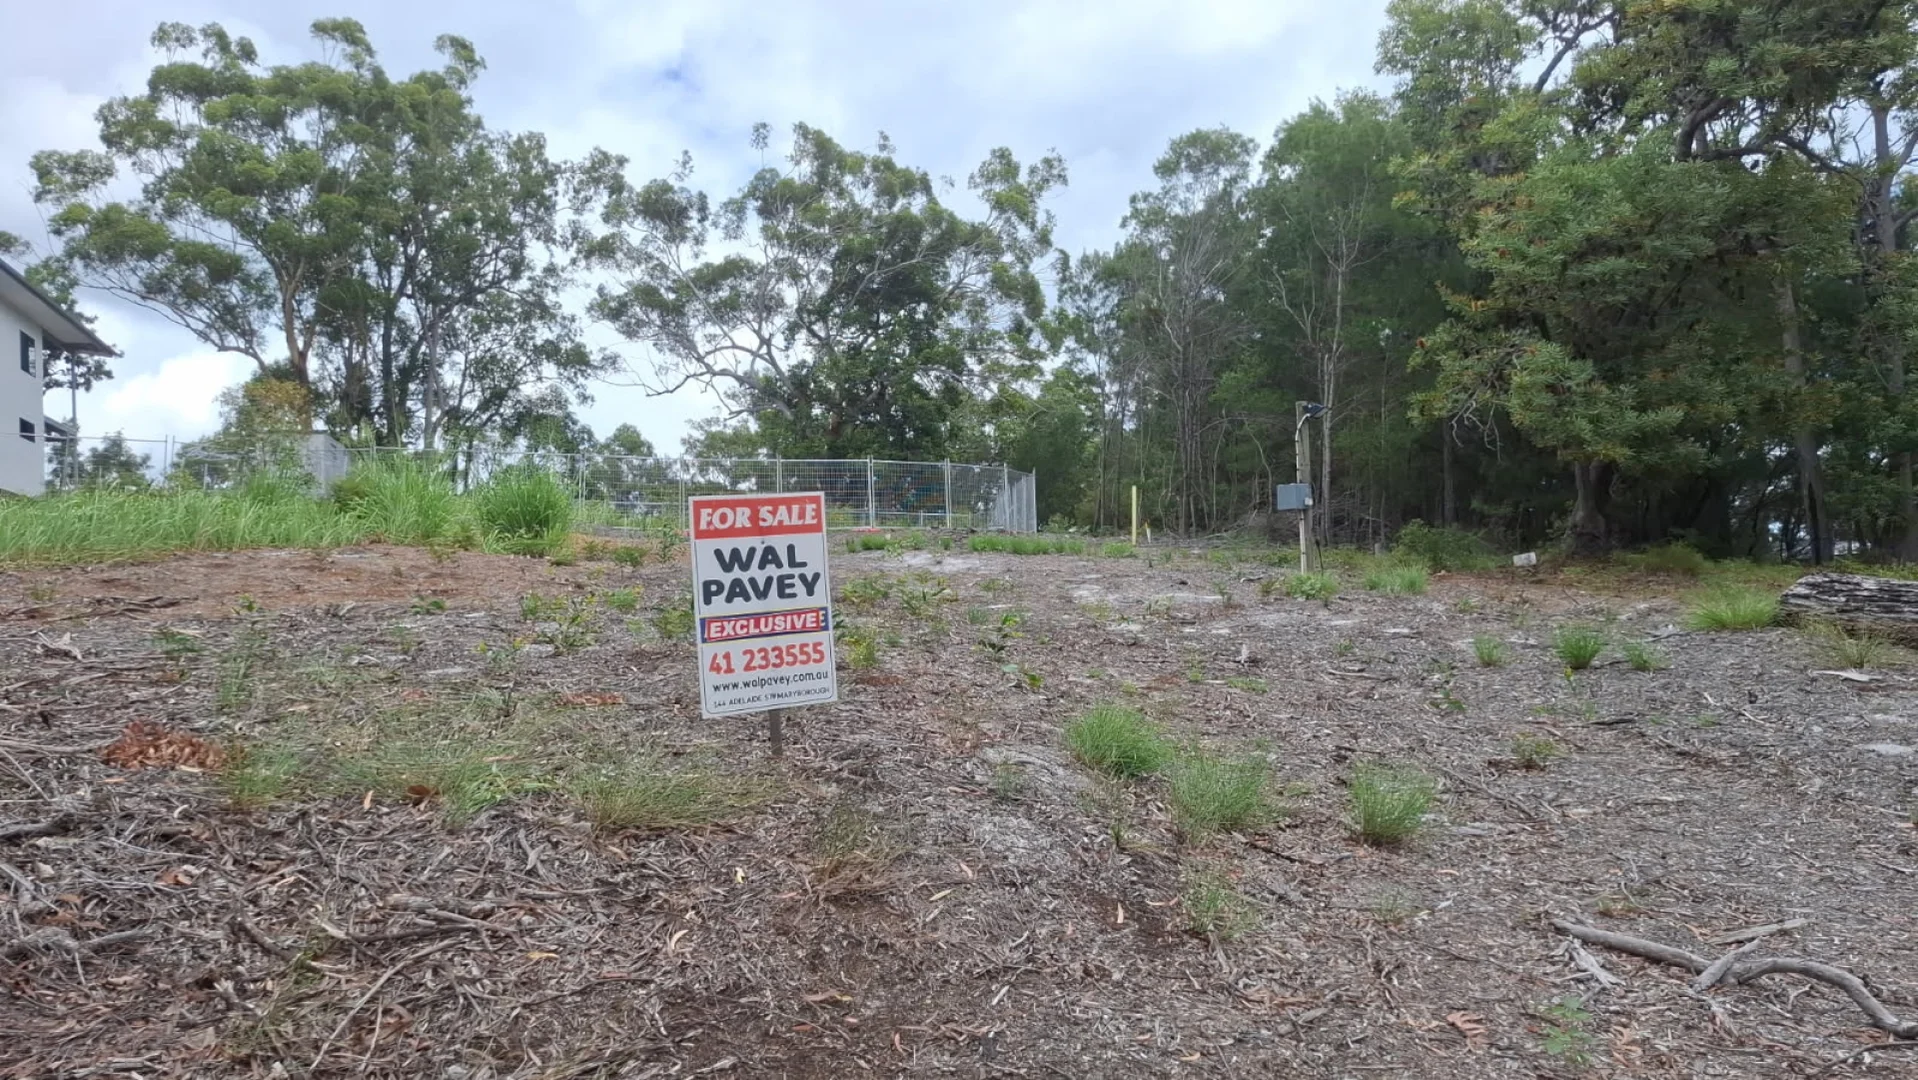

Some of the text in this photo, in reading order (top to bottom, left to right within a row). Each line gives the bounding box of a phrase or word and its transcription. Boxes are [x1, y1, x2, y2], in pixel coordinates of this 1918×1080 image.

[699, 504, 818, 530] FOR SALE
[714, 544, 808, 573] WAL
[702, 572, 821, 605] PAVEY
[709, 612, 818, 638] EXCLUSIVE
[708, 641, 825, 675] 41 233555
[712, 671, 828, 692] www.walpavey.com.au
